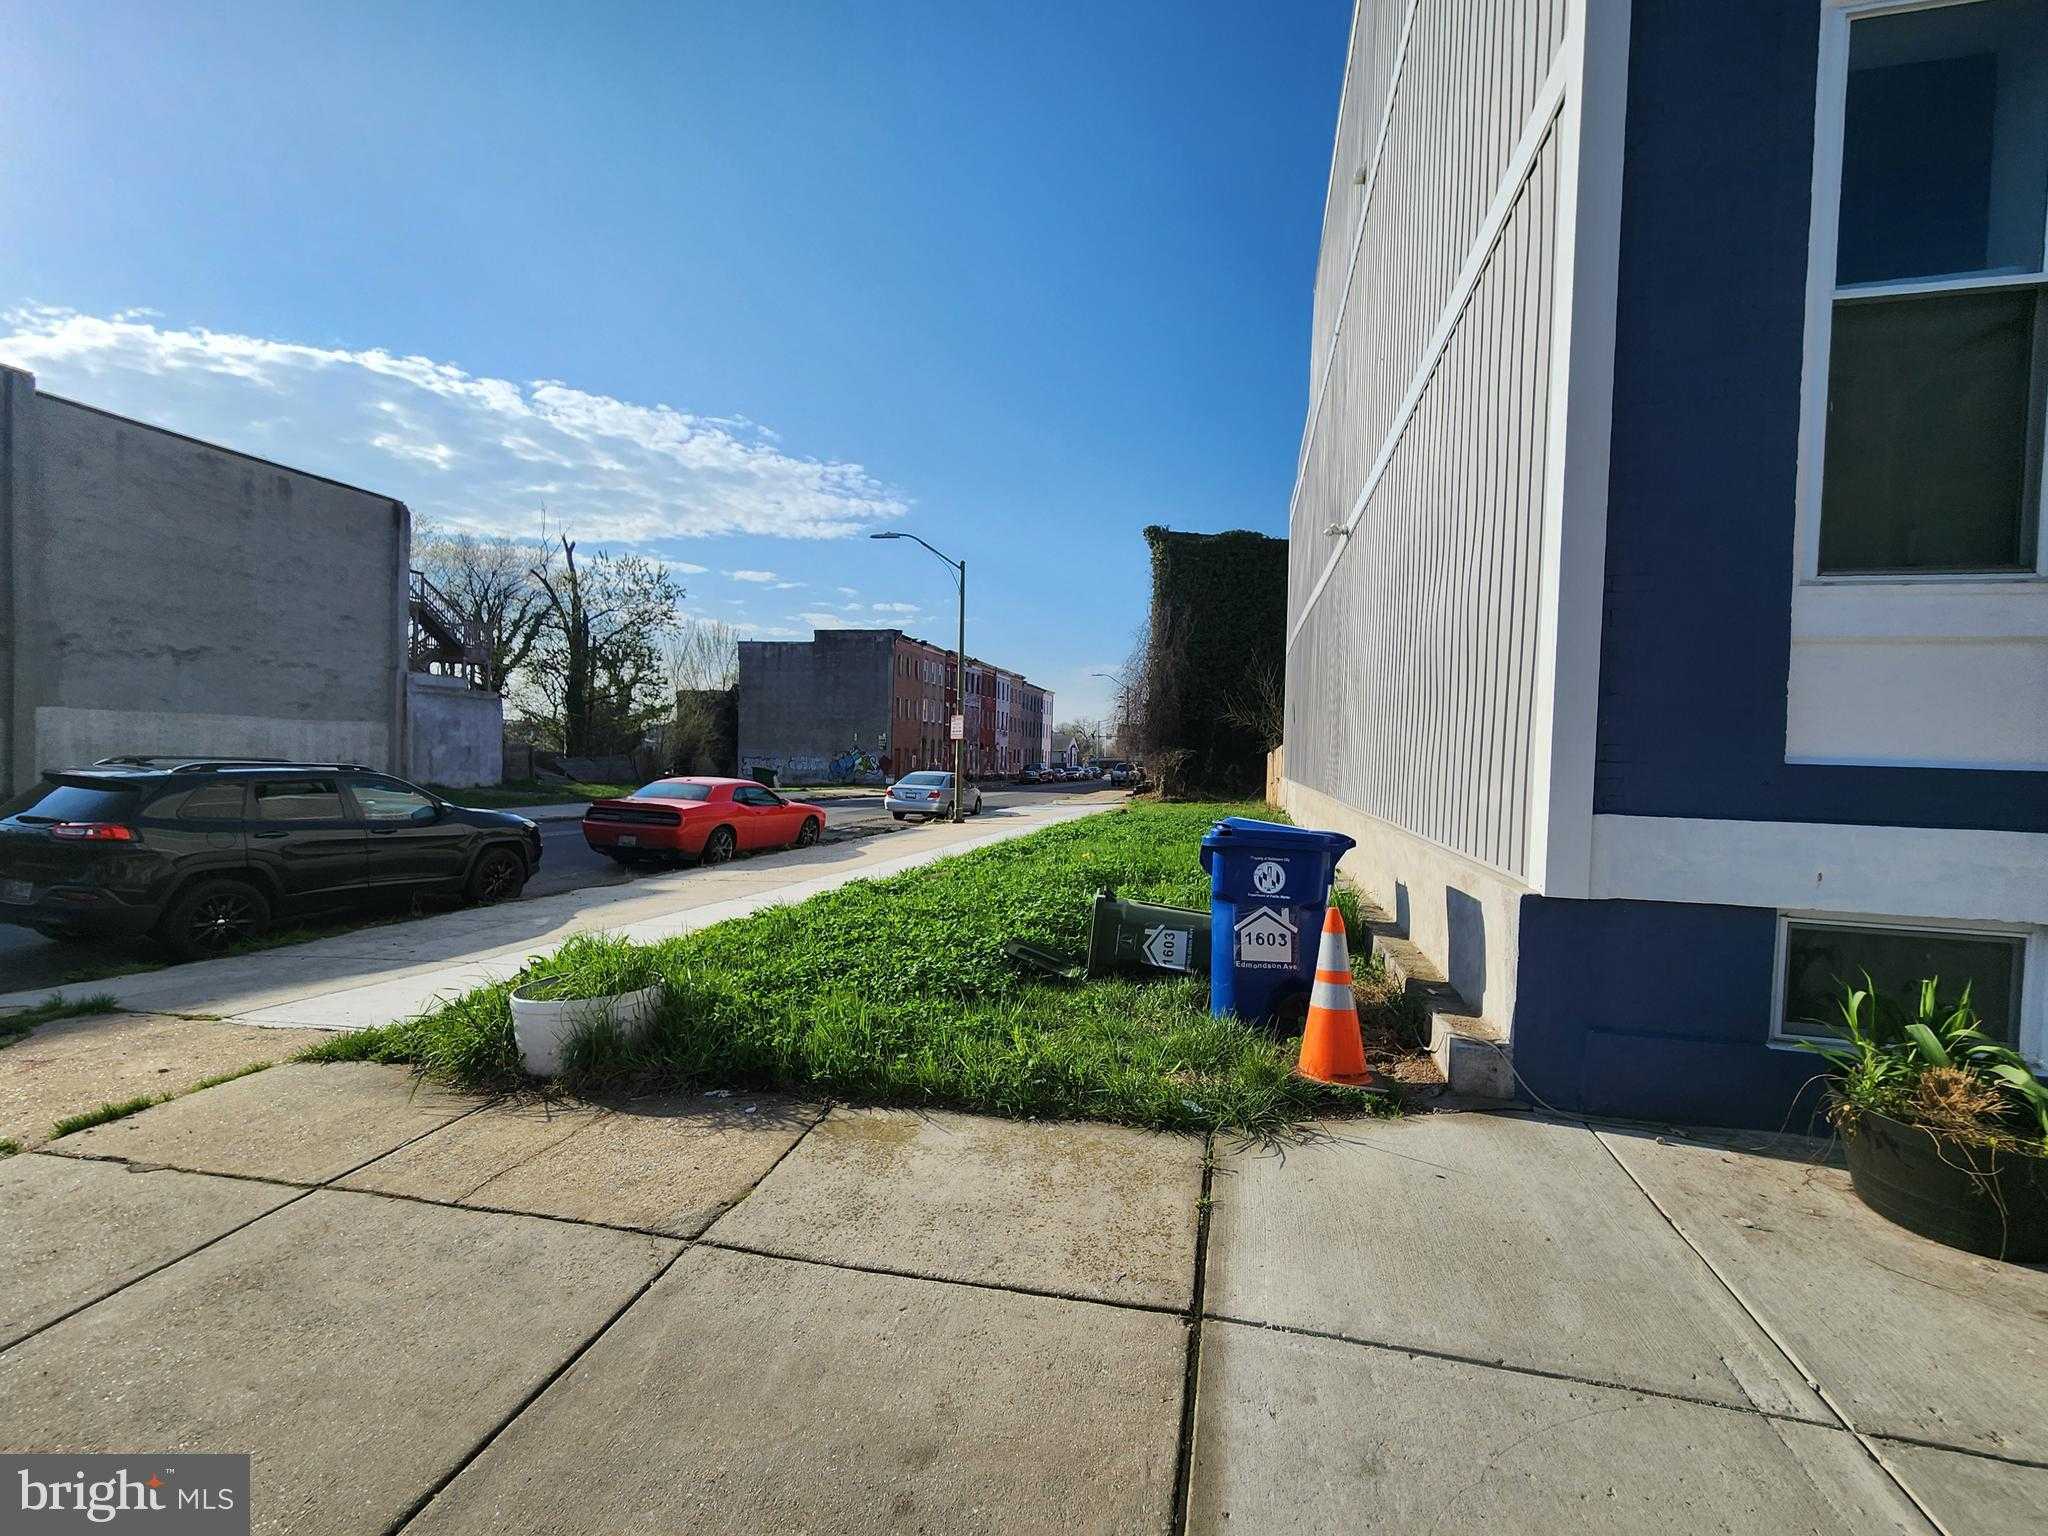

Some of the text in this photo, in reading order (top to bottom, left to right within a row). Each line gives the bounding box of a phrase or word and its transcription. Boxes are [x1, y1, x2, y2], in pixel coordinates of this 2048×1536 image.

[1245, 932, 1288, 947] 1603
[1162, 932, 1176, 965] 1603
[1235, 960, 1282, 970] Edmondson
